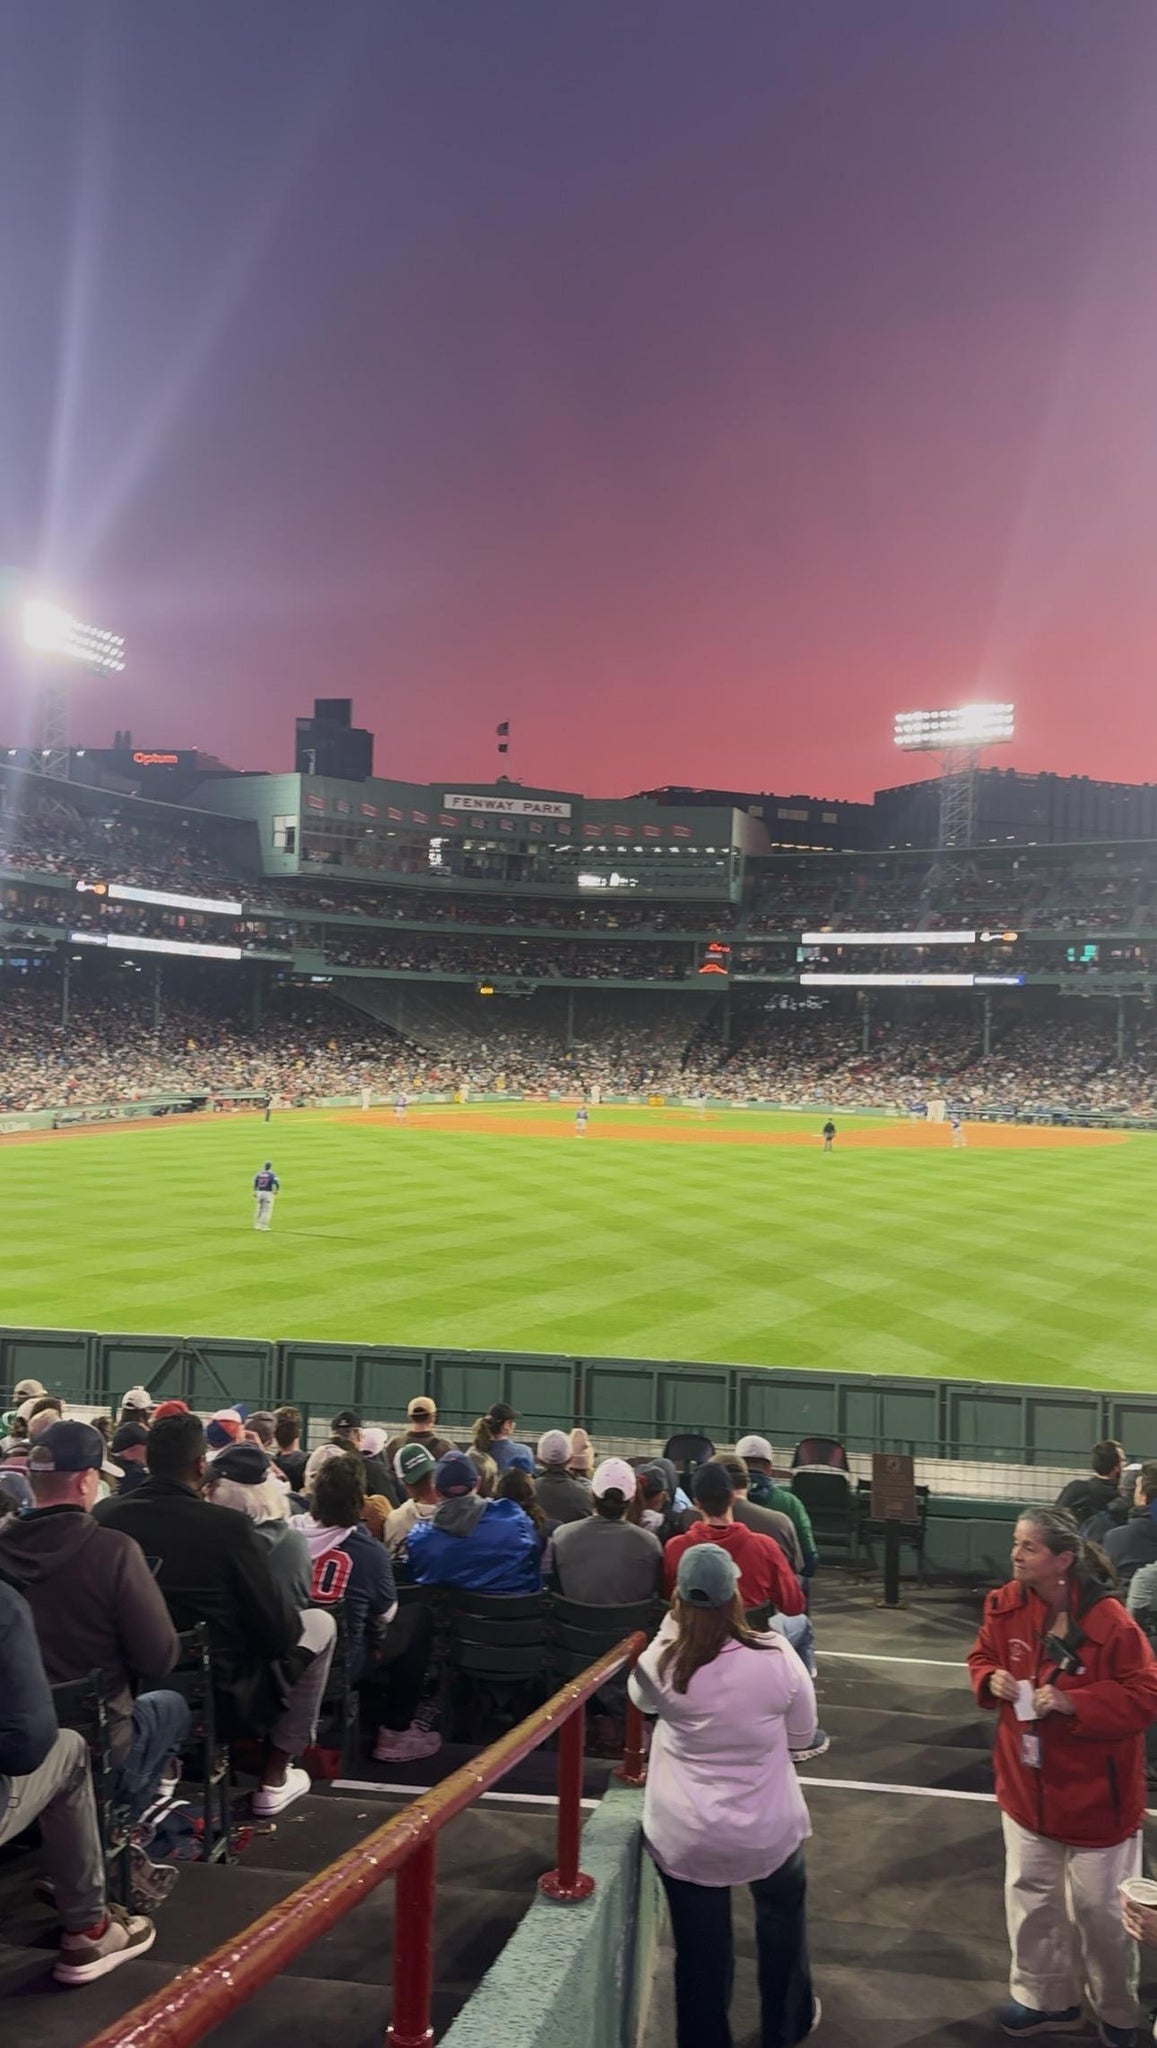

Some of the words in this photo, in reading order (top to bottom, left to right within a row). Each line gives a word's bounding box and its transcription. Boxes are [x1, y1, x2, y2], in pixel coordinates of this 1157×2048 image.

[452, 797, 514, 811] FENWAY
[522, 802, 564, 815] PARK
[309, 1548, 353, 1604] 0
